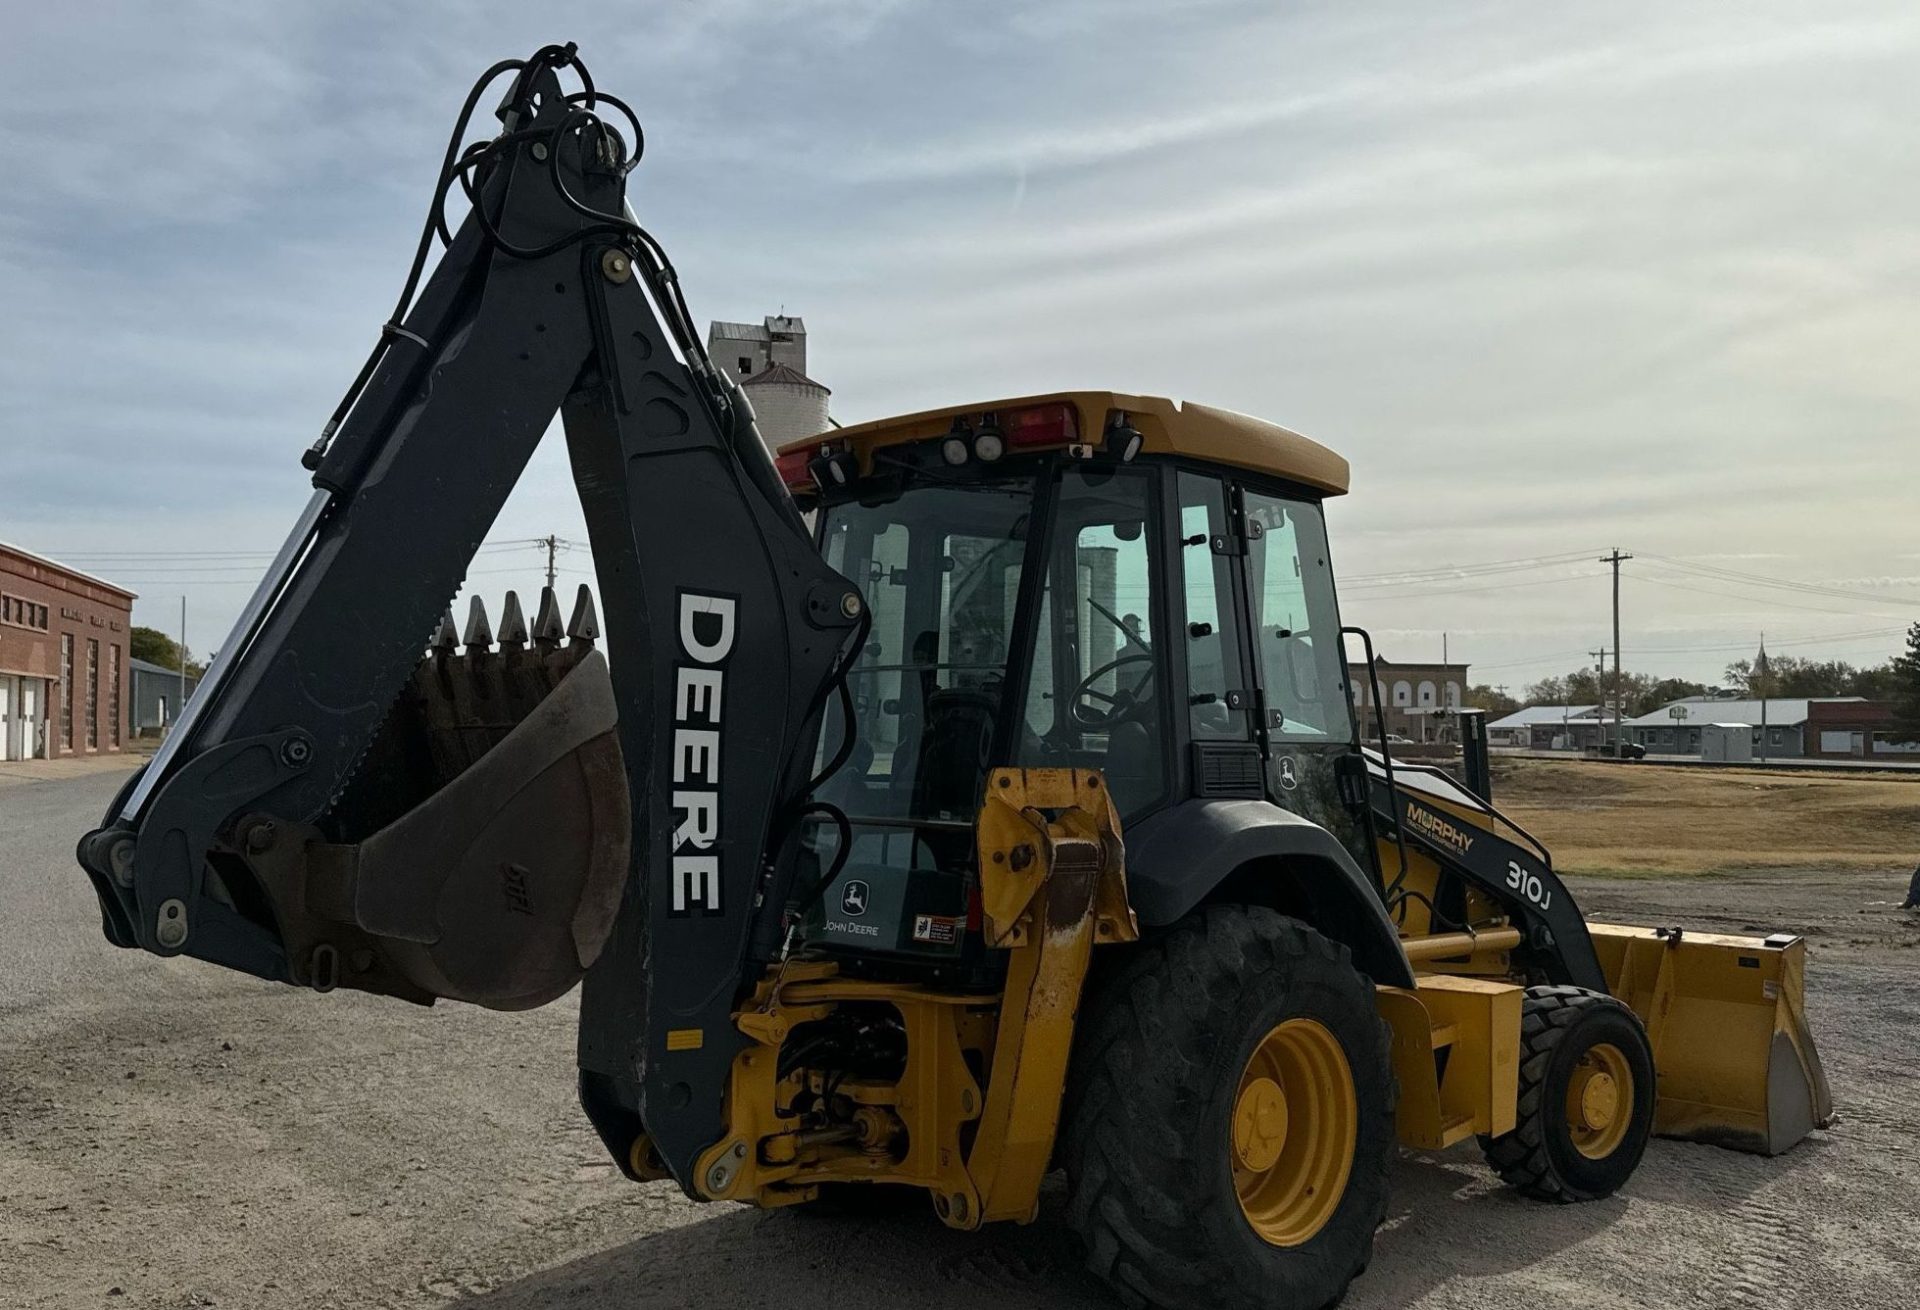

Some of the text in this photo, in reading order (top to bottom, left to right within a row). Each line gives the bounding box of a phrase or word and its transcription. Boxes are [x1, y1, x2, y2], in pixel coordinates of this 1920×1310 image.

[672, 593, 736, 911] DEERE
[1406, 802, 1474, 851] MURPHY
[1505, 860, 1551, 911] 310J
[823, 919, 879, 936] JOHN DEERE
